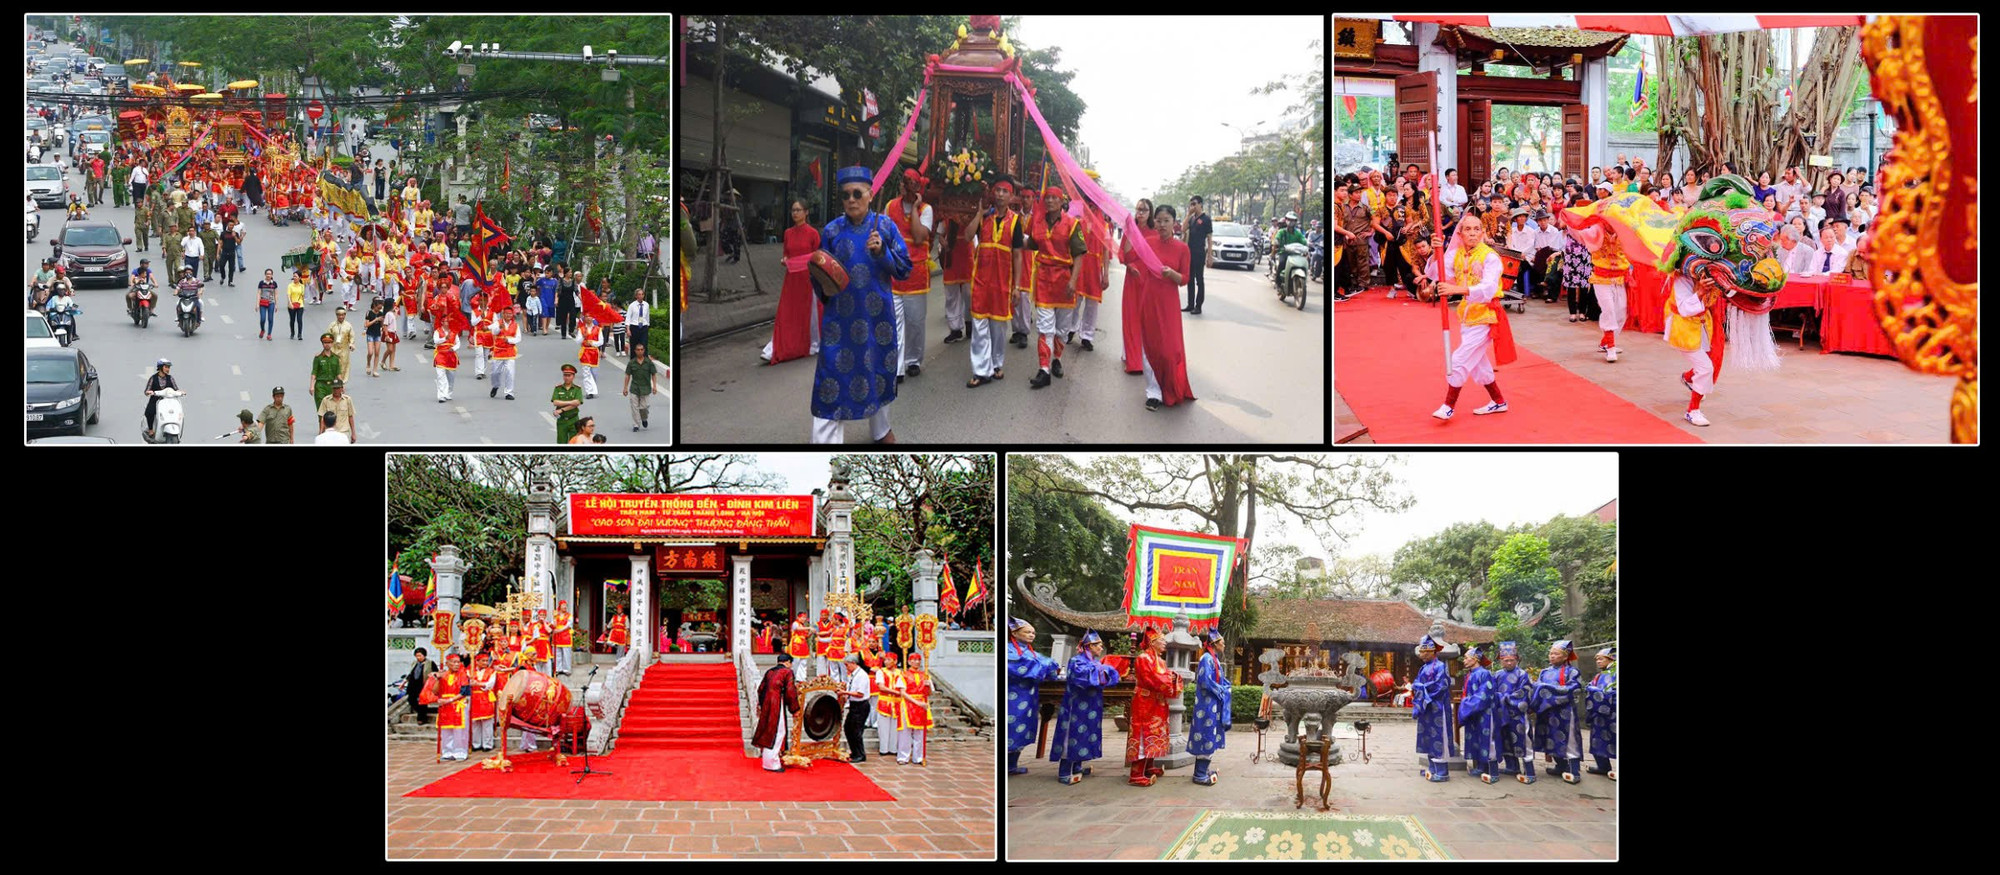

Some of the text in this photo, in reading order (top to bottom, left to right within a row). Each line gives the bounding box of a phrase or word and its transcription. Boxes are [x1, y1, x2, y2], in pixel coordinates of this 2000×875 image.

[600, 497, 617, 510] HỘI
[619, 496, 658, 508] TRUYỀN
[661, 496, 694, 508] THỐNG
[697, 497, 718, 509] ĐỀN
[727, 498, 752, 509] ĐÌNH
[754, 500, 774, 509] KIM
[777, 498, 799, 509] LIÊN
[1174, 580, 1196, 589] NAM
